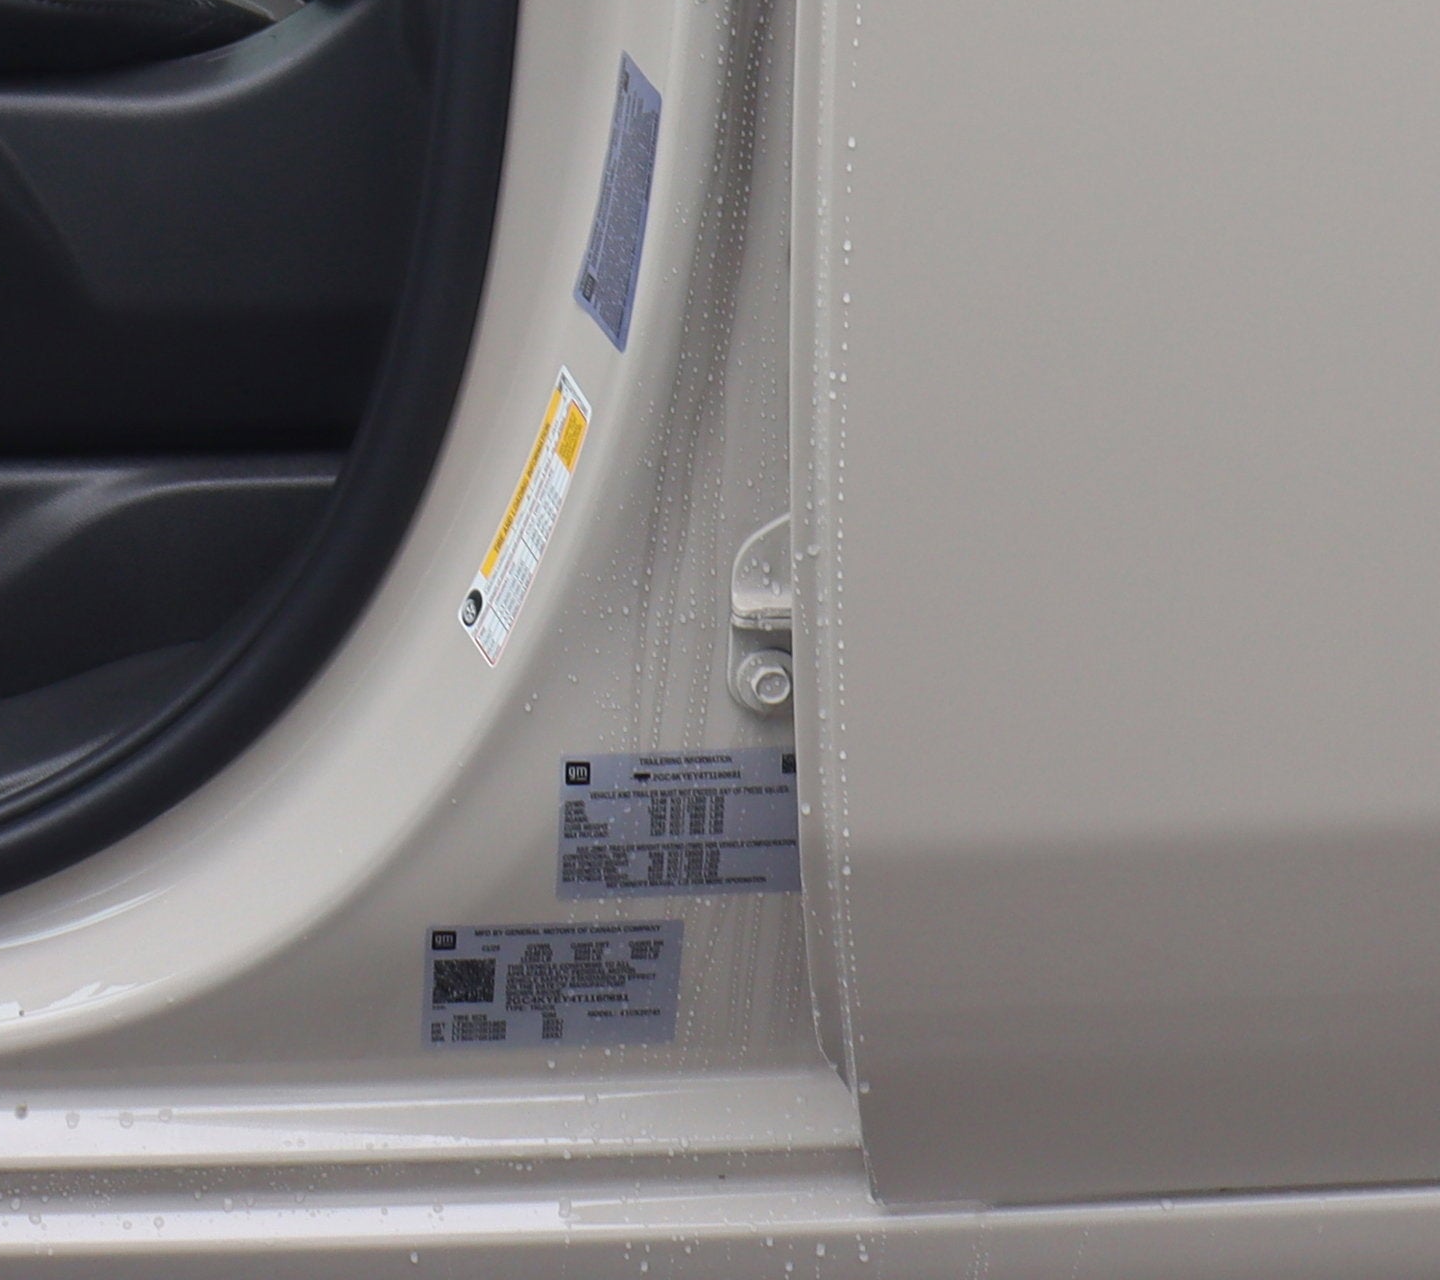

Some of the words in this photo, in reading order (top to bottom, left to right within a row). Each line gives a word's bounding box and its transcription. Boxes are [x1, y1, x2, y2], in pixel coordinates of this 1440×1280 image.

[639, 756, 682, 766] TRAILERING
[684, 755, 733, 764] INFORMATION
[568, 766, 588, 780] gm
[493, 928, 504, 937] BY
[505, 928, 541, 936] GENERAL
[543, 927, 575, 935] MOTORS
[577, 926, 588, 934] OF
[589, 926, 621, 934] CANADA
[436, 935, 454, 946] gm
